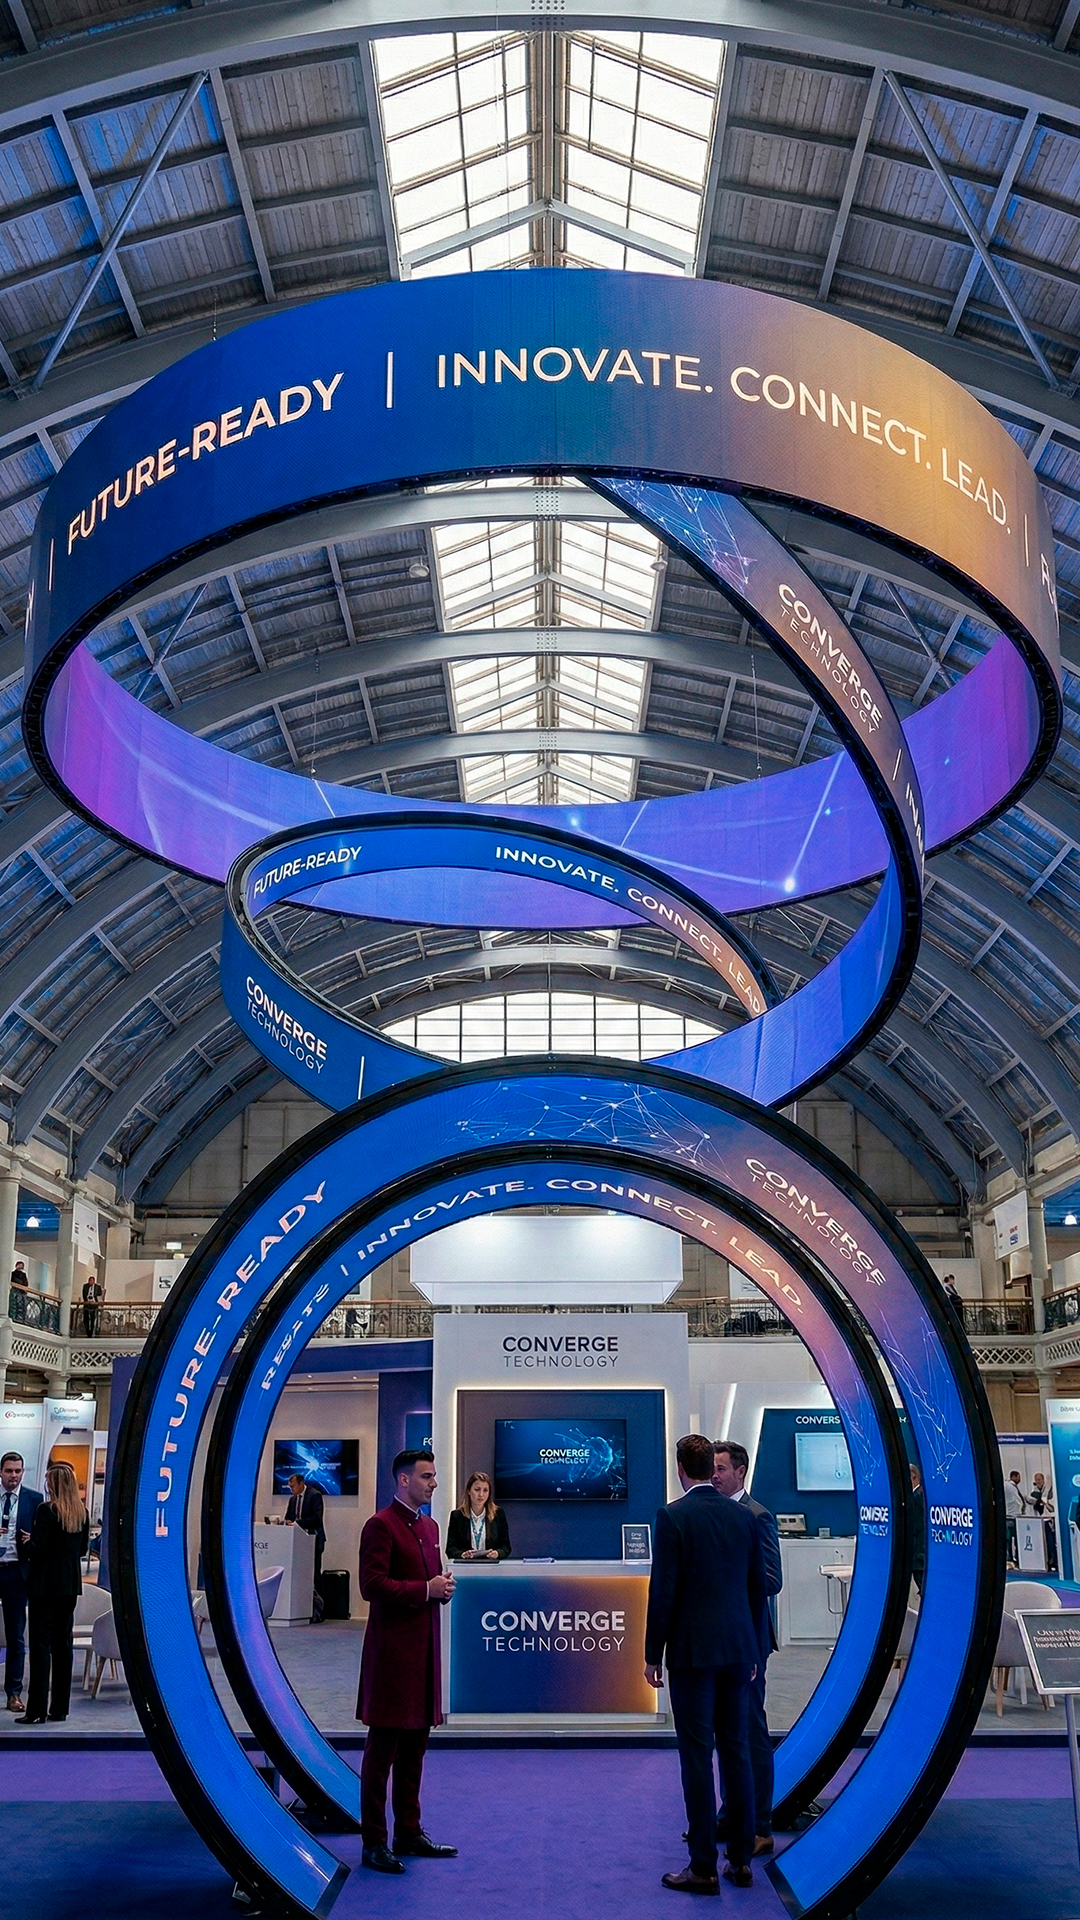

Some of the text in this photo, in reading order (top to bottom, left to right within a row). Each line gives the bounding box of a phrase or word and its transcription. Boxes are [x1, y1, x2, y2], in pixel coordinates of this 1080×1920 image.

[67, 346, 1012, 556] FUTURE-READY INNOVATE. CONNECT. LEAD.
[778, 583, 883, 730] CONVERGE
[779, 604, 876, 734] TECHNOLOGY
[253, 845, 362, 899] FUTURE-READY
[495, 846, 619, 893] INNOVATE.
[627, 887, 724, 963] CONNECT.
[246, 975, 328, 1061] CONVERGE
[246, 996, 325, 1075] TECHNOLOGY
[357, 1179, 535, 1261] INNOVATE.
[545, 1177, 719, 1237] CONNECT.
[728, 1235, 805, 1315] LEAD.
[745, 1157, 887, 1287] CONVERGE
[749, 1172, 877, 1286] TECHNOLOGY
[502, 1335, 619, 1353] CONVERGE
[503, 1354, 619, 1369] TECHNOLOGY
[539, 1448, 591, 1457] CONVERGE
[929, 1506, 974, 1528] CONVERGE
[481, 1610, 626, 1632] CONVERGE
[482, 1636, 626, 1653] TECHNOLOGY
